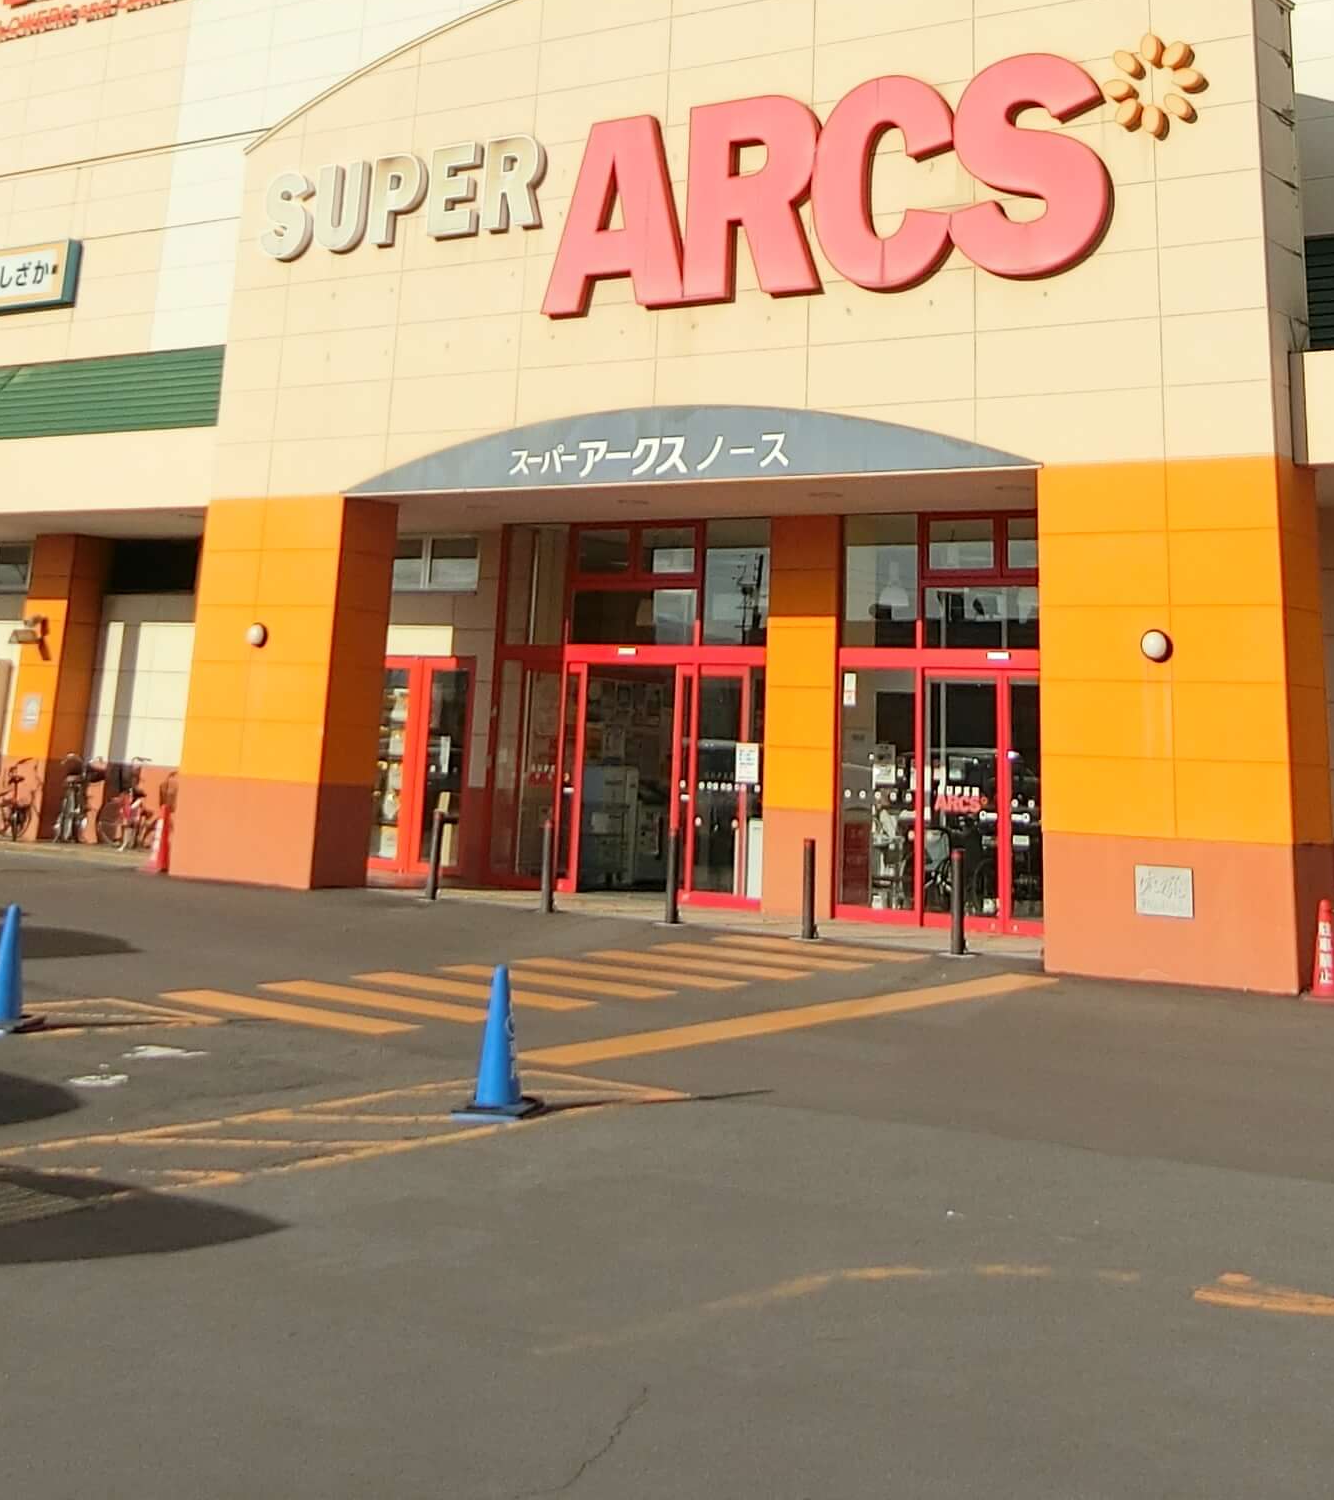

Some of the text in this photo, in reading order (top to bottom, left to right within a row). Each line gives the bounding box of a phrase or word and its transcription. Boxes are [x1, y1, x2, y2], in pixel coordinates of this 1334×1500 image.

[261, 52, 1115, 319] SUPER ARCS
[697, 432, 789, 471] ノース
[933, 795, 983, 813] ARCS
